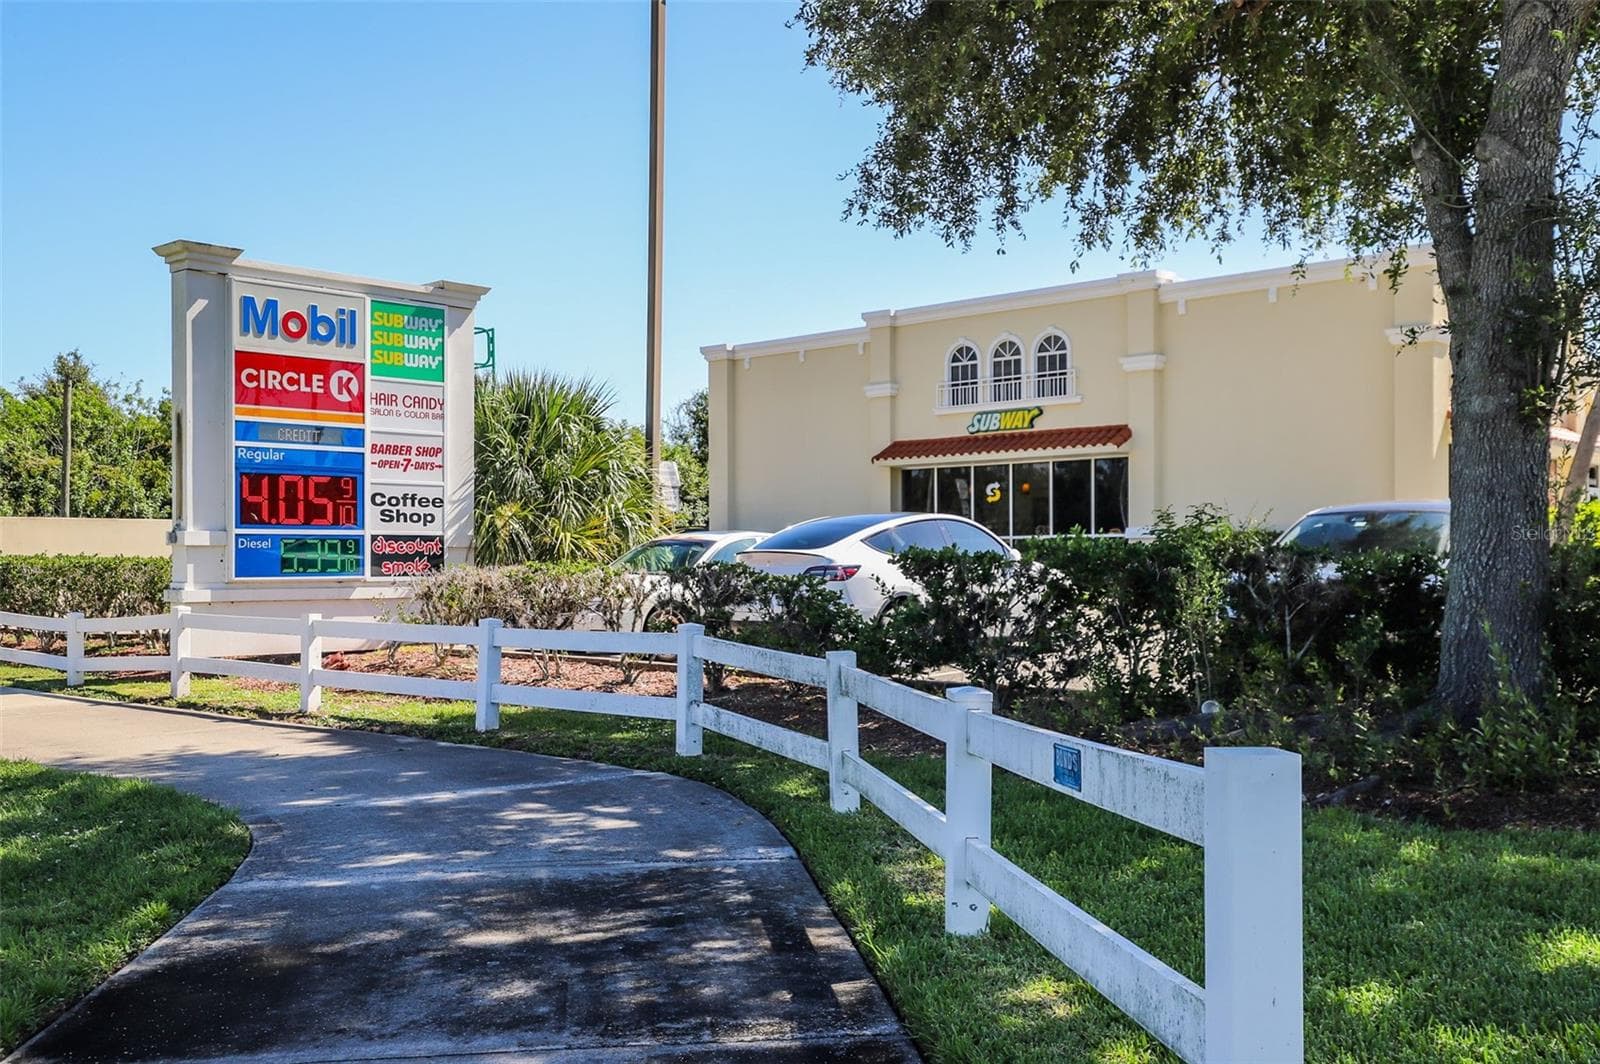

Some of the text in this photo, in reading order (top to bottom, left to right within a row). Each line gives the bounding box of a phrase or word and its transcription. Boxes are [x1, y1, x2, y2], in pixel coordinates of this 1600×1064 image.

[239, 295, 357, 348] Mobil
[371, 311, 443, 332] SUBWAY
[371, 330, 443, 351] SUBWAY
[371, 350, 443, 370] SUBWAY
[240, 368, 358, 402] CIRCLE K
[370, 392, 445, 411] HAIR CANDY
[370, 407, 394, 417] SALON
[403, 411, 430, 420] COLOR
[968, 407, 1042, 434] SUBWAY
[278, 428, 321, 442] CREDIT
[237, 448, 285, 462] Regular
[370, 443, 443, 457] BARBER SHOP
[242, 475, 333, 525] 4.05
[370, 492, 444, 508] Coffee
[379, 509, 436, 526] Shop
[238, 538, 272, 549] Diesel
[371, 535, 442, 555] discount
[381, 556, 431, 575] smoke
